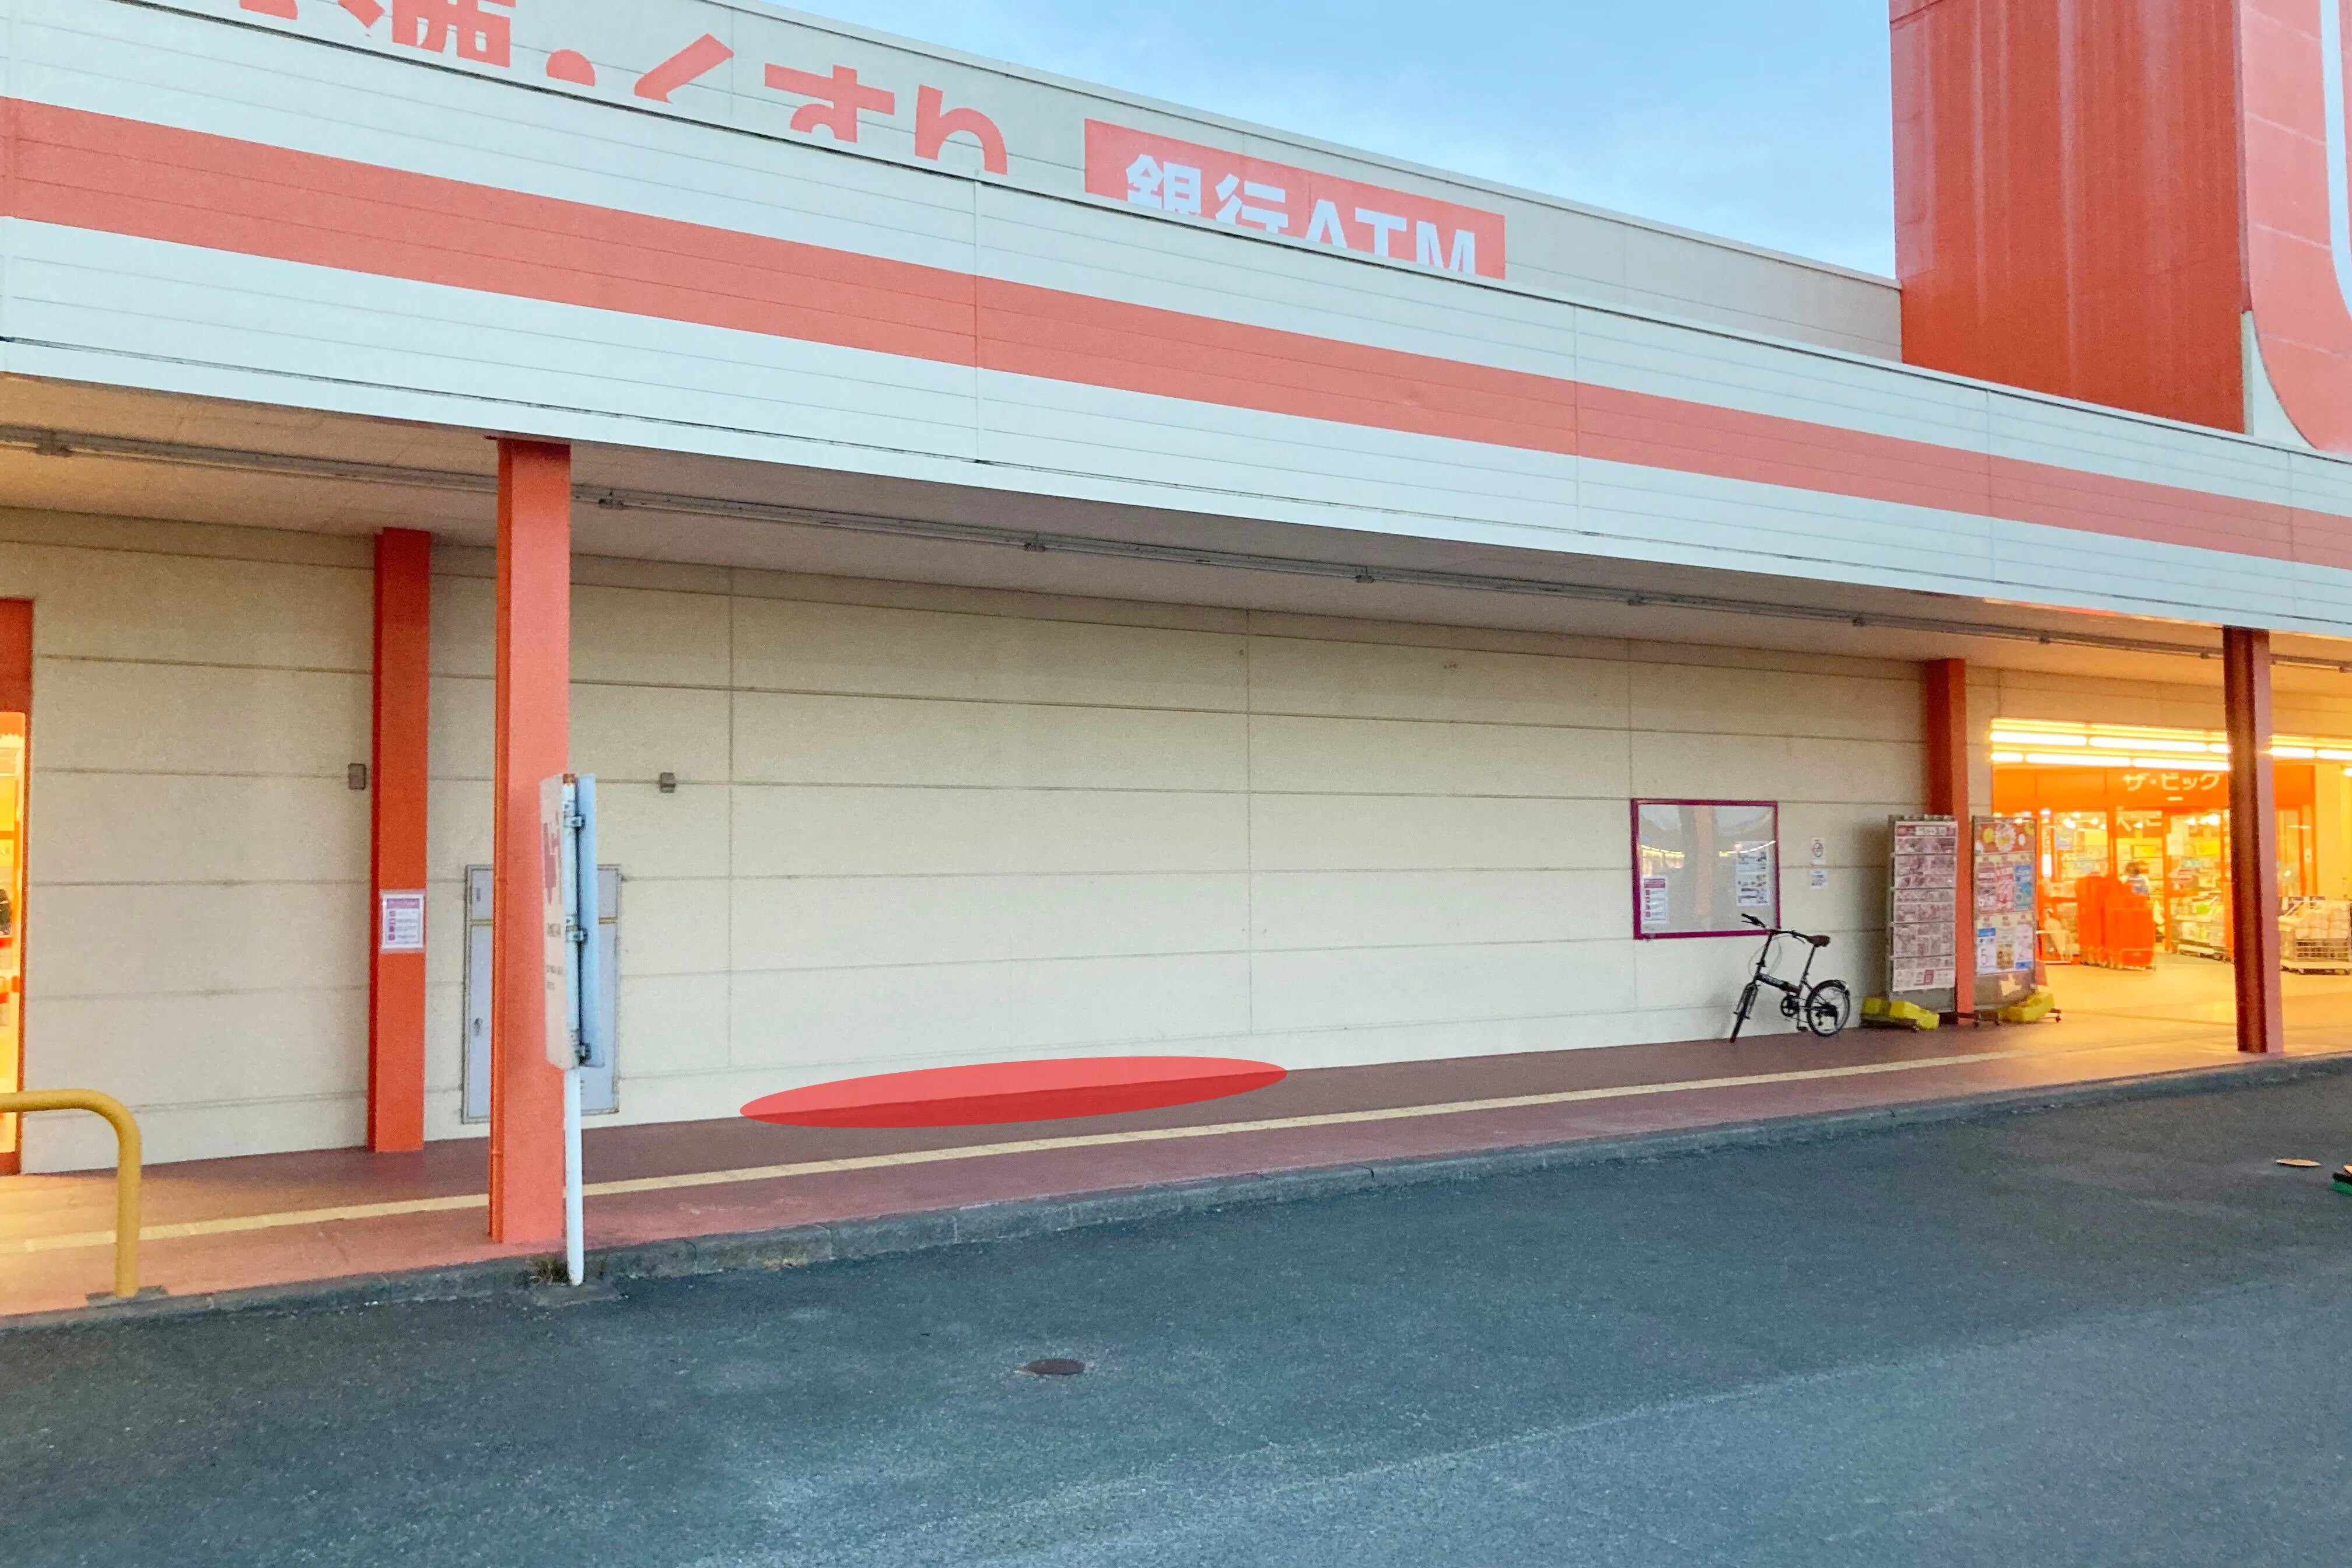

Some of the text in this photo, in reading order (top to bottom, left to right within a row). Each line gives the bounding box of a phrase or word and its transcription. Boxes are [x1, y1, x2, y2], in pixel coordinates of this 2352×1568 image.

[2122, 772, 2224, 792] ザ・ビッグ
